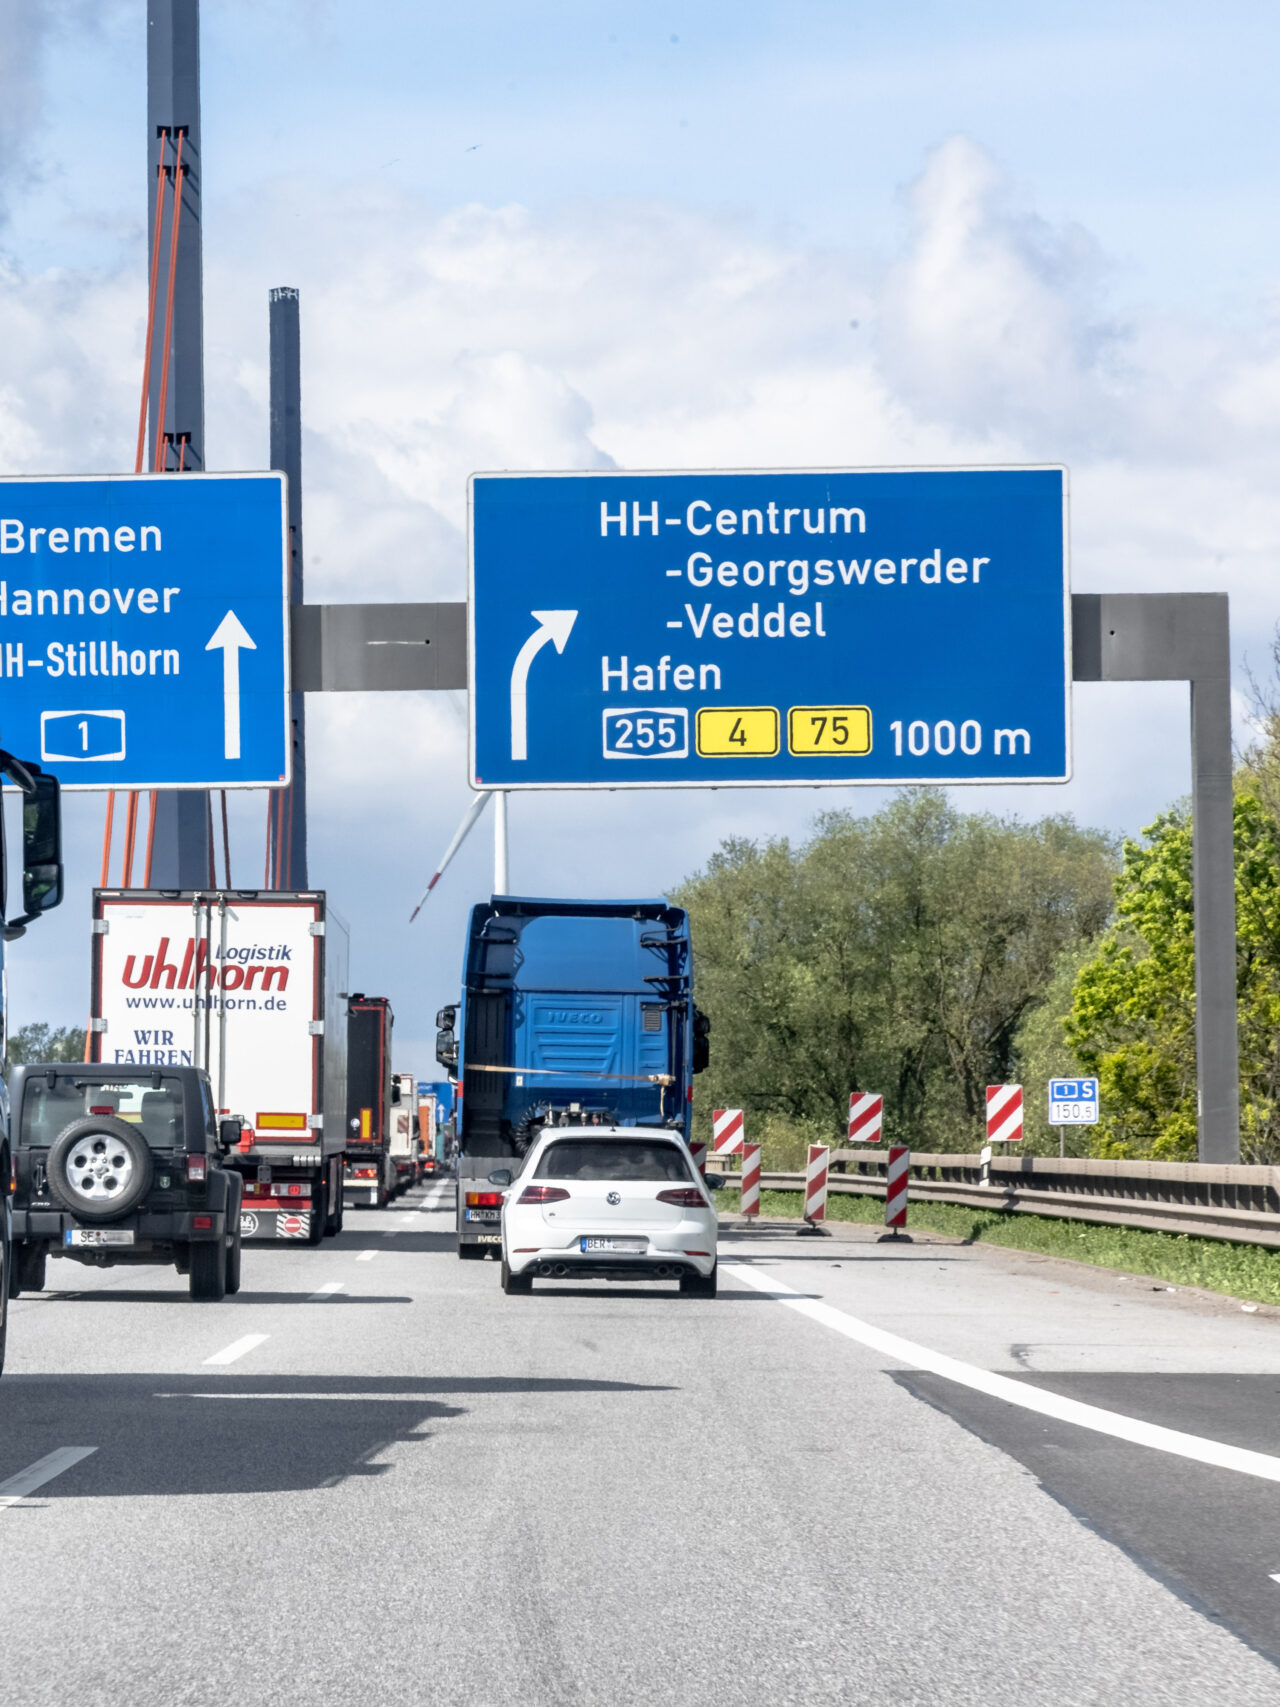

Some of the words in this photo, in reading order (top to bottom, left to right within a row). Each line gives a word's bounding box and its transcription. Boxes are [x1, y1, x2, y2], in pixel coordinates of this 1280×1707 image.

[600, 499, 867, 537] HH-Centrum
[0, 518, 162, 554] Bremen
[665, 548, 991, 596] -Georgswerder
[666, 601, 827, 639] -Veddel
[601, 655, 722, 692] Hafen
[78, 720, 89, 752] 1
[614, 718, 677, 749] 255
[727, 717, 748, 747] 4
[810, 716, 849, 746] 75
[889, 719, 982, 757] 1000
[993, 728, 1032, 756] m
[215, 944, 293, 964] Logistik
[125, 994, 287, 1011] www.uhlhorn.de
[548, 1010, 603, 1024] IVECO
[133, 1029, 174, 1046] WIR
[114, 1048, 193, 1067] FAHREN
[1082, 1082, 1093, 1098] S
[1056, 1104, 1092, 1119] 150.5
